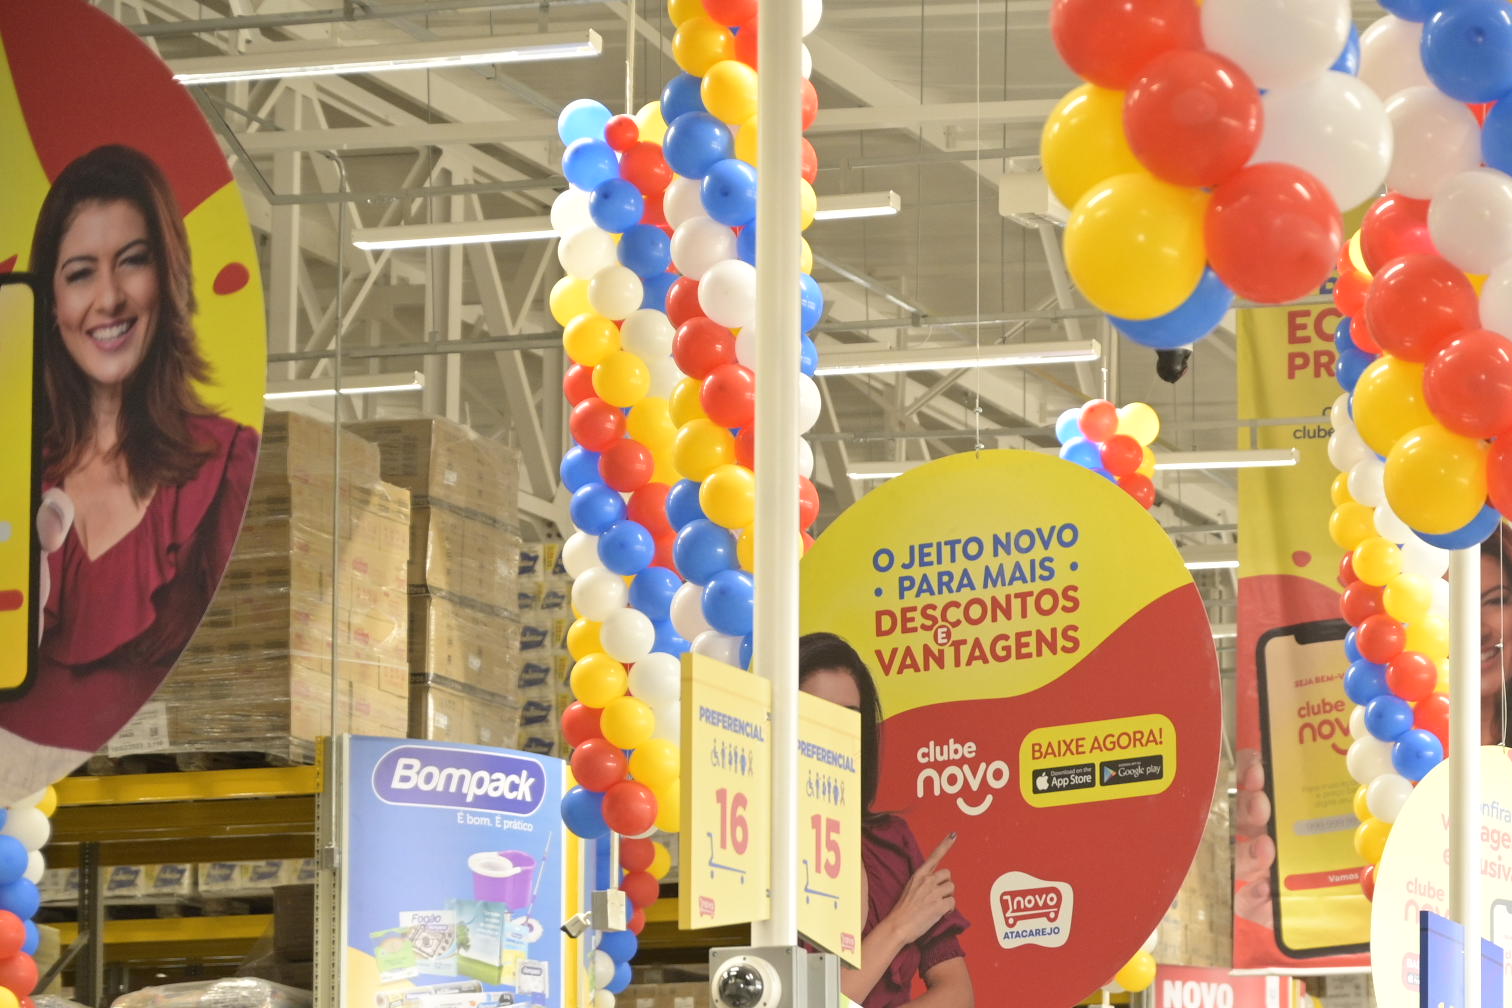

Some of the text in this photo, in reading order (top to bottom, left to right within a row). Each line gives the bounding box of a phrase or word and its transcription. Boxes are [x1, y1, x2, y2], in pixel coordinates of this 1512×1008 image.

[873, 523, 1079, 573] O JEITO NOVO
[898, 556, 1056, 600] PARA MAIS
[875, 584, 1081, 638] DESCONTOS
[874, 624, 1081, 677] VANTAGENS
[1298, 699, 1346, 718] clube
[699, 706, 765, 742] PREFERENCIAL
[916, 738, 977, 764] clube
[1032, 728, 1164, 761] BAIXE AGORA!
[391, 757, 535, 803] Bompack
[916, 760, 1010, 798] novo
[1051, 767, 1079, 777] Download
[1051, 773, 1092, 788] App Store
[1118, 763, 1161, 779] Google play
[457, 811, 464, 824] É
[466, 814, 493, 826] bom.
[503, 817, 534, 832] prático
[715, 787, 749, 855] 16
[810, 813, 842, 879] 15
[1327, 873, 1359, 882] Vamos
[1406, 878, 1445, 902] clube
[1013, 892, 1058, 911] novo
[1003, 927, 1061, 940] ATACAREJO
